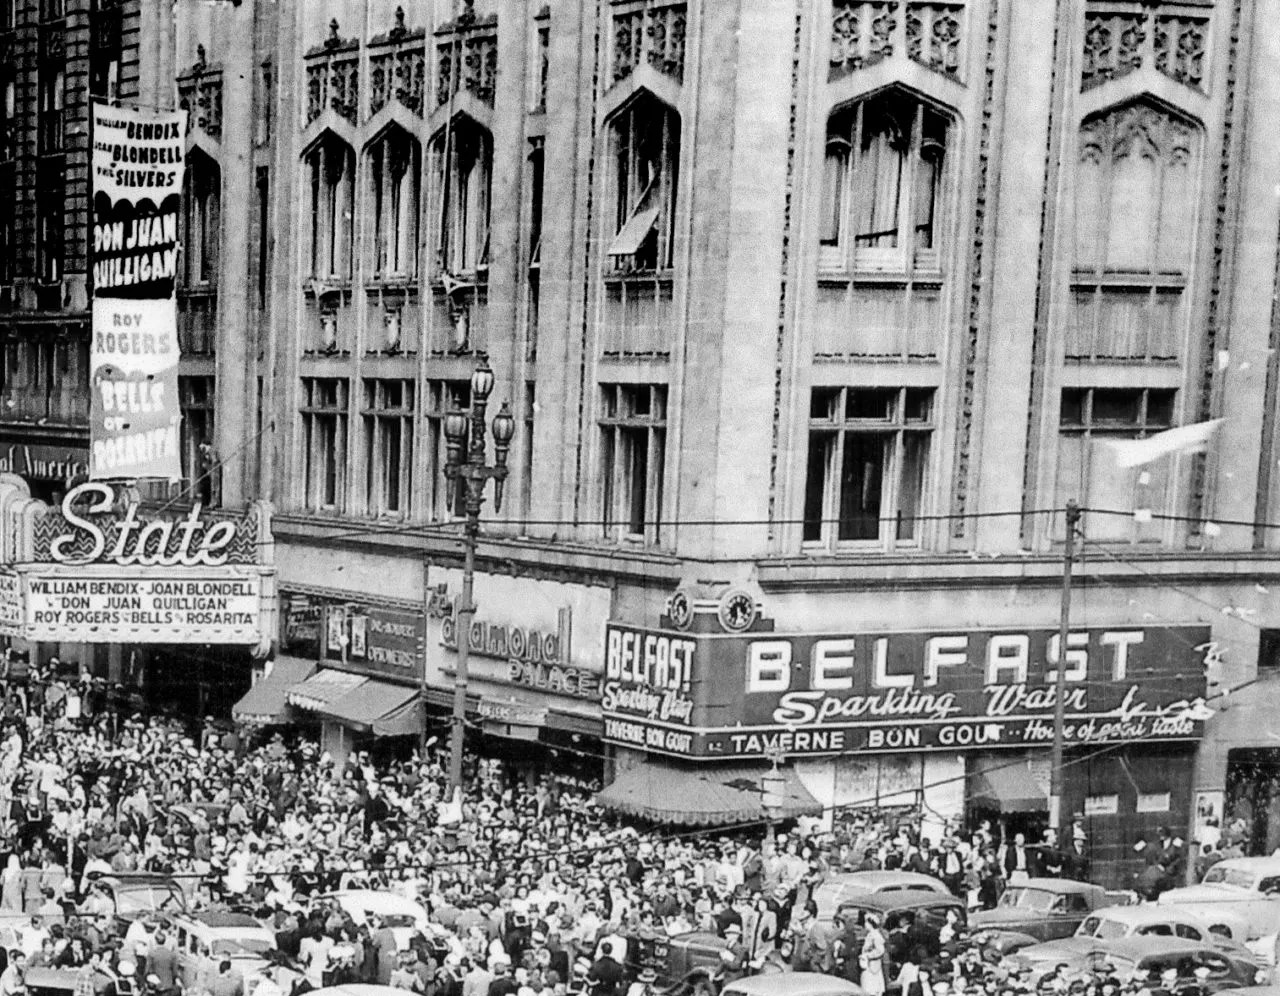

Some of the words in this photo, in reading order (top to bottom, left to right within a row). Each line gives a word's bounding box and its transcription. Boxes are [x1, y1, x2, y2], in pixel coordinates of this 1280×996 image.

[127, 121, 180, 140] BENDIX
[113, 144, 182, 164] BLONDELL
[116, 169, 177, 188] SILVERS
[126, 212, 177, 250] JUAN
[113, 313, 142, 327] ROY
[96, 331, 171, 355] ROGERS
[0, 446, 15, 472] of
[49, 482, 236, 566] State
[29, 582, 87, 595] WILLIAM
[146, 582, 183, 595] JOAN
[186, 583, 256, 597] BLONDELL
[102, 597, 140, 610] JUAN
[34, 610, 61, 624] ROY
[65, 610, 120, 624] ROGERS
[441, 596, 572, 666] damond
[507, 658, 593, 697] PALACE
[606, 629, 697, 692] BELFAST
[745, 631, 1145, 694] BELFAST
[602, 681, 661, 720] Sparkling
[660, 689, 695, 725] Water
[773, 686, 962, 723] Sparkling
[983, 683, 1088, 716] Water
[604, 718, 645, 747] TAVERNE
[646, 727, 665, 747] BON
[666, 731, 693, 753] GOUT
[731, 730, 845, 754] TAVERNE
[869, 727, 920, 748] BON
[1023, 719, 1075, 741] Houe
[1077, 717, 1096, 742] of
